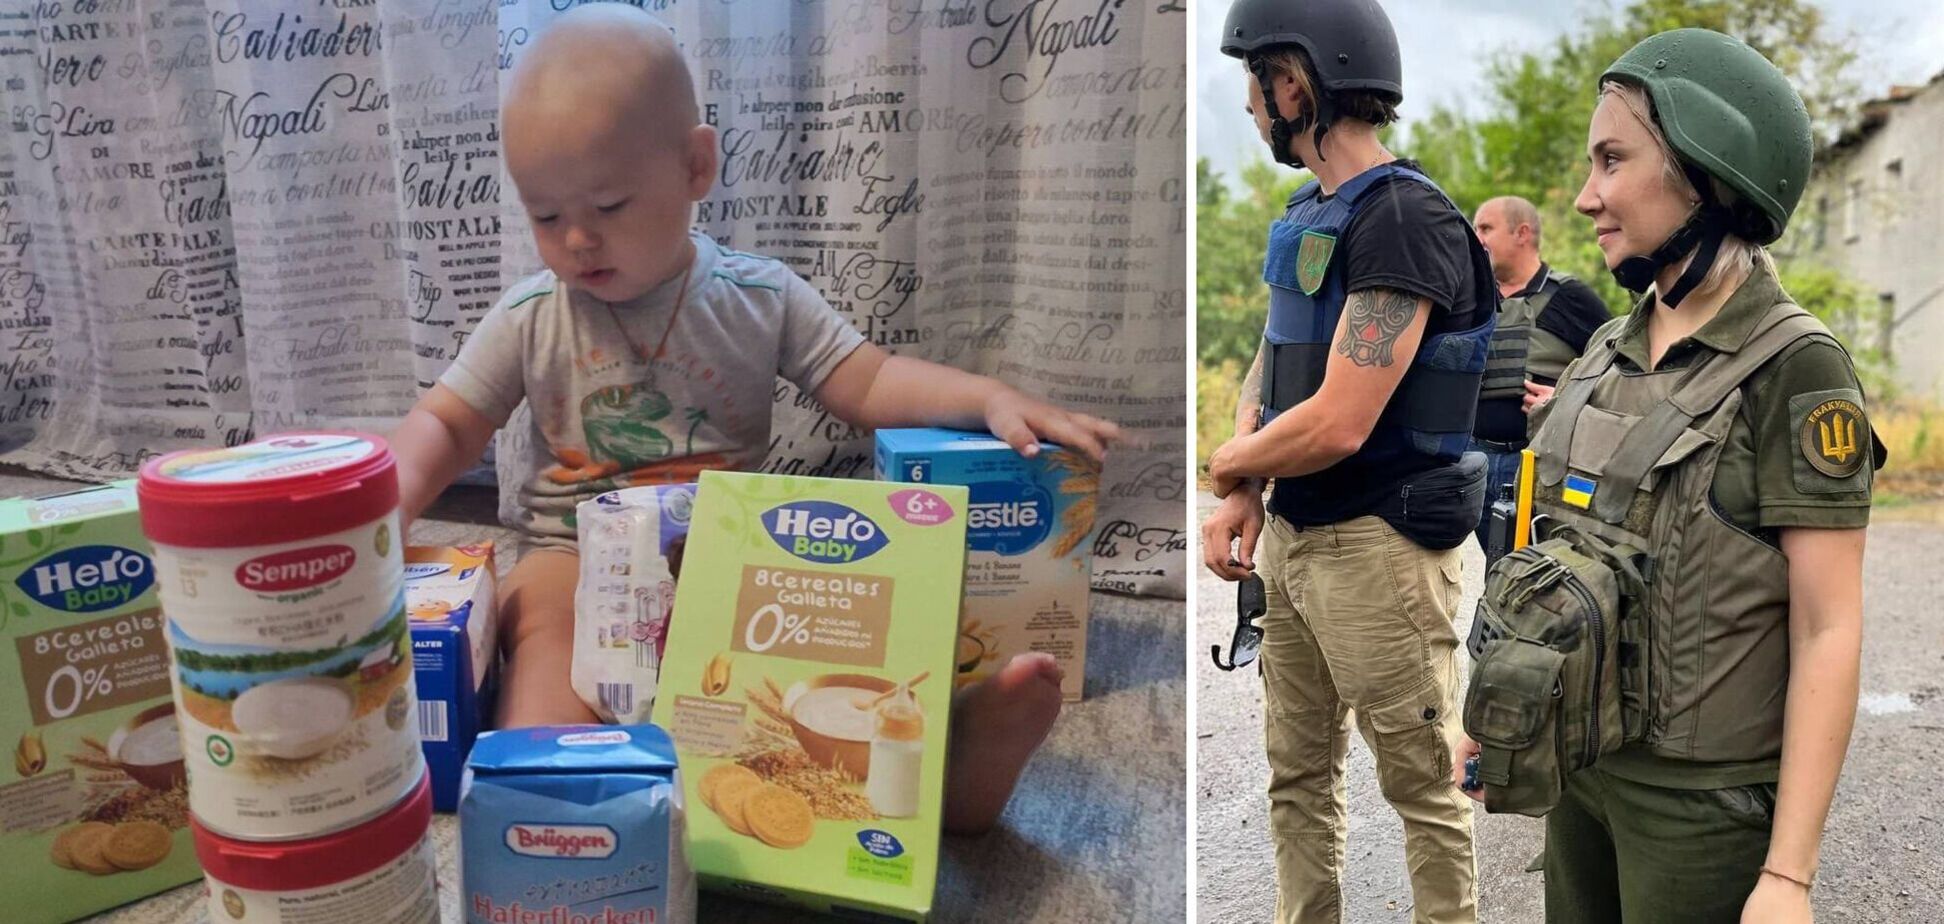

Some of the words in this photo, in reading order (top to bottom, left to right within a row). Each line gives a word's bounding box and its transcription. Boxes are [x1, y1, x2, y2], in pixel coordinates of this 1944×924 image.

[794, 100, 823, 113] non
[858, 107, 955, 134] AMORE
[454, 131, 483, 146] non
[91, 147, 109, 159] DI
[911, 465, 924, 482] 6
[906, 492, 939, 514] 6+
[967, 500, 1039, 529] estlé
[775, 508, 876, 541] Hero
[793, 537, 857, 562] Baby
[35, 550, 145, 596] Hero
[244, 549, 354, 586] Semper
[64, 582, 133, 611] Baby
[777, 589, 853, 611] Galleta
[745, 603, 812, 653] 0%
[66, 636, 145, 663] Galleta
[414, 640, 443, 648] ALTER
[45, 664, 113, 719] 0%
[515, 827, 610, 856] Brüggen
[870, 832, 891, 845] SIN
[473, 893, 657, 924] Haferflocken
